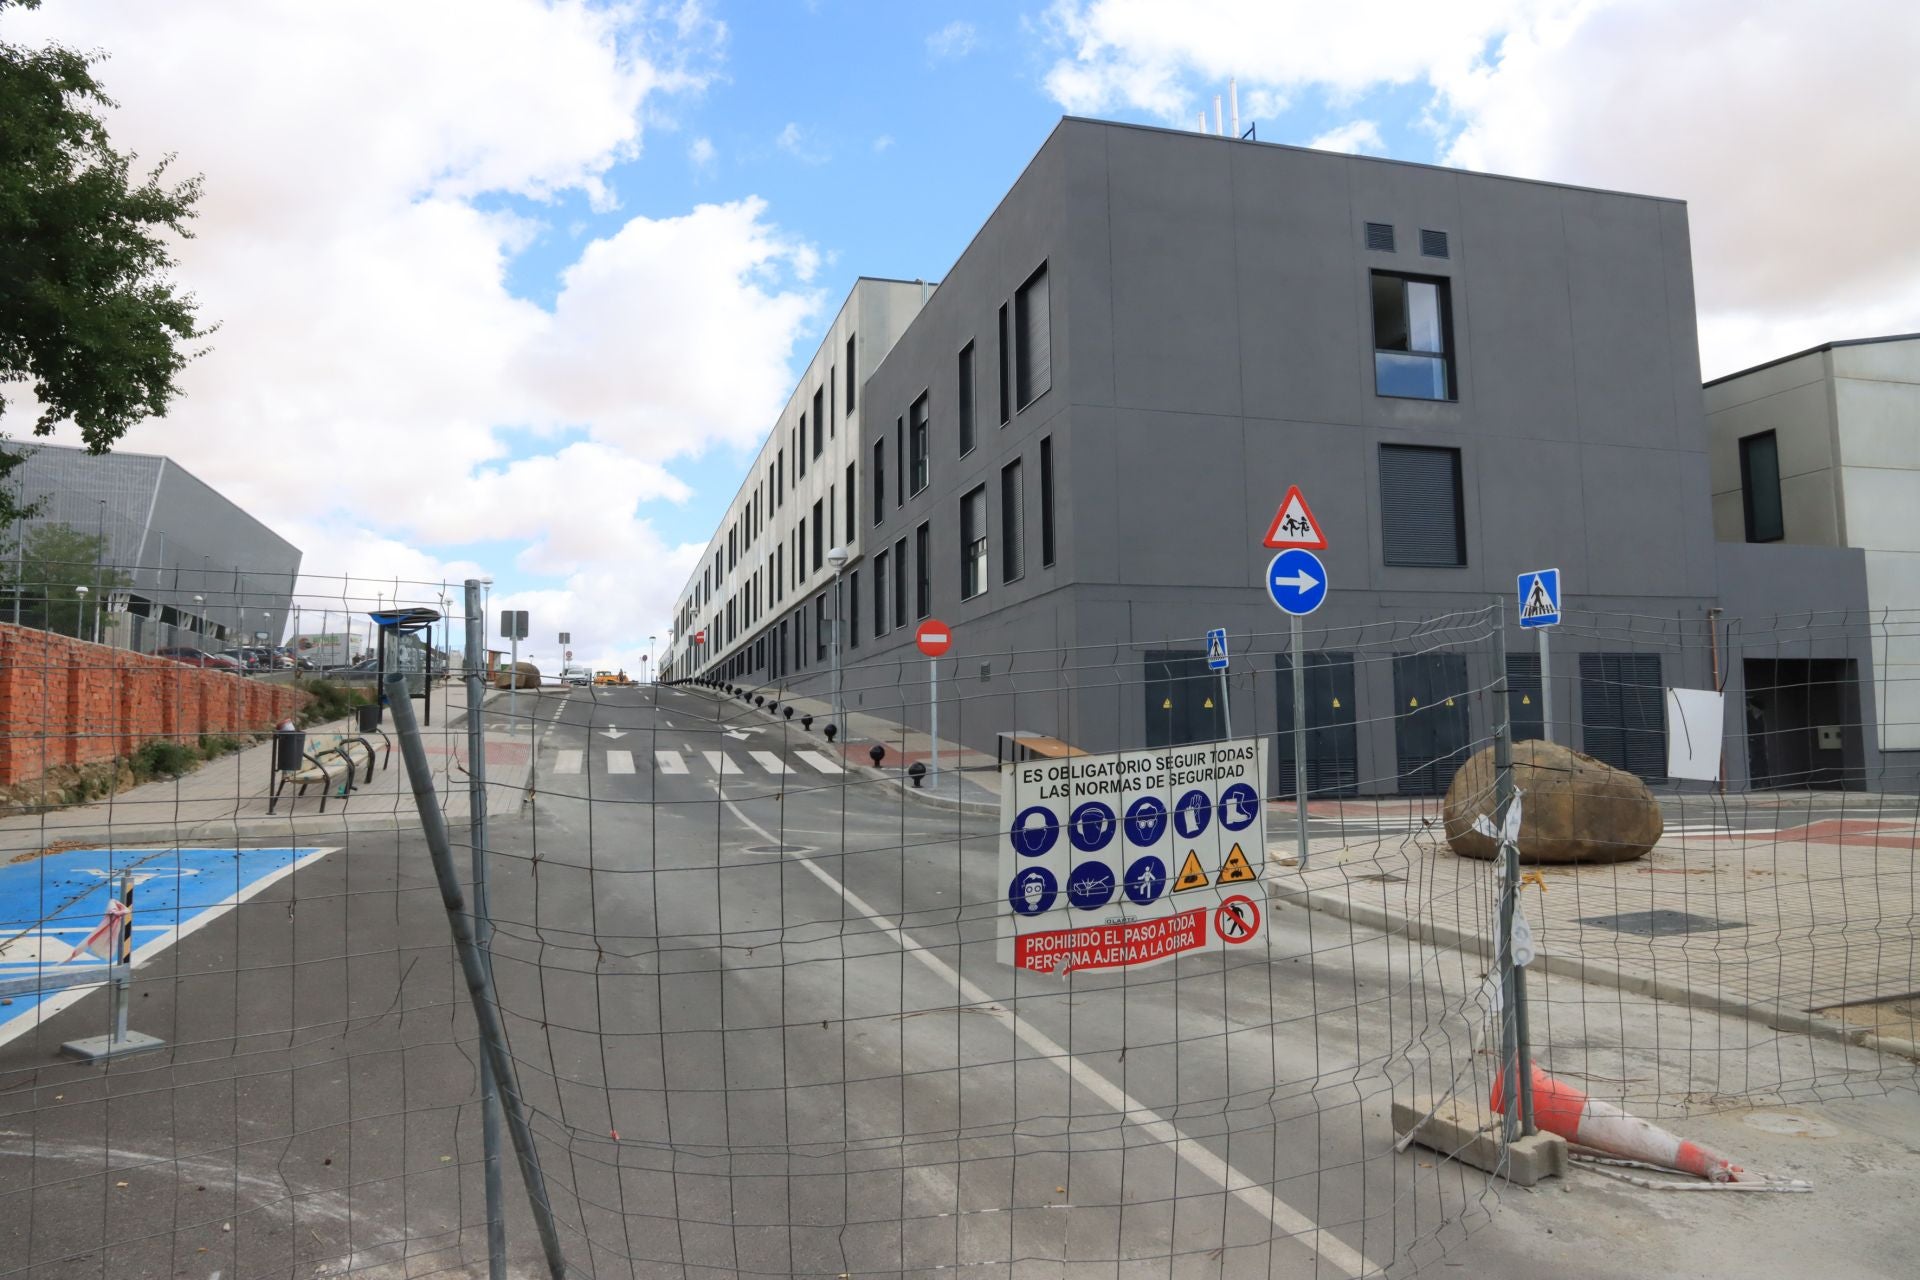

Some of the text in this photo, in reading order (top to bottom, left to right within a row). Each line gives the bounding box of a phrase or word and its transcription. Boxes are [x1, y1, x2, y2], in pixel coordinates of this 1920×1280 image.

[1023, 746, 1254, 783] ES OBLIGATORIO SEGUIR TODAS
[1040, 764, 1245, 799] LAS NORMAS DE SEGURIDAD
[1026, 914, 1196, 953] PROHIBIDO EL PASO A TODA
[1093, 946, 1138, 964] AJENA
[1140, 944, 1148, 959] A
[1150, 940, 1164, 956] LA
[1165, 931, 1195, 951] OBRA
